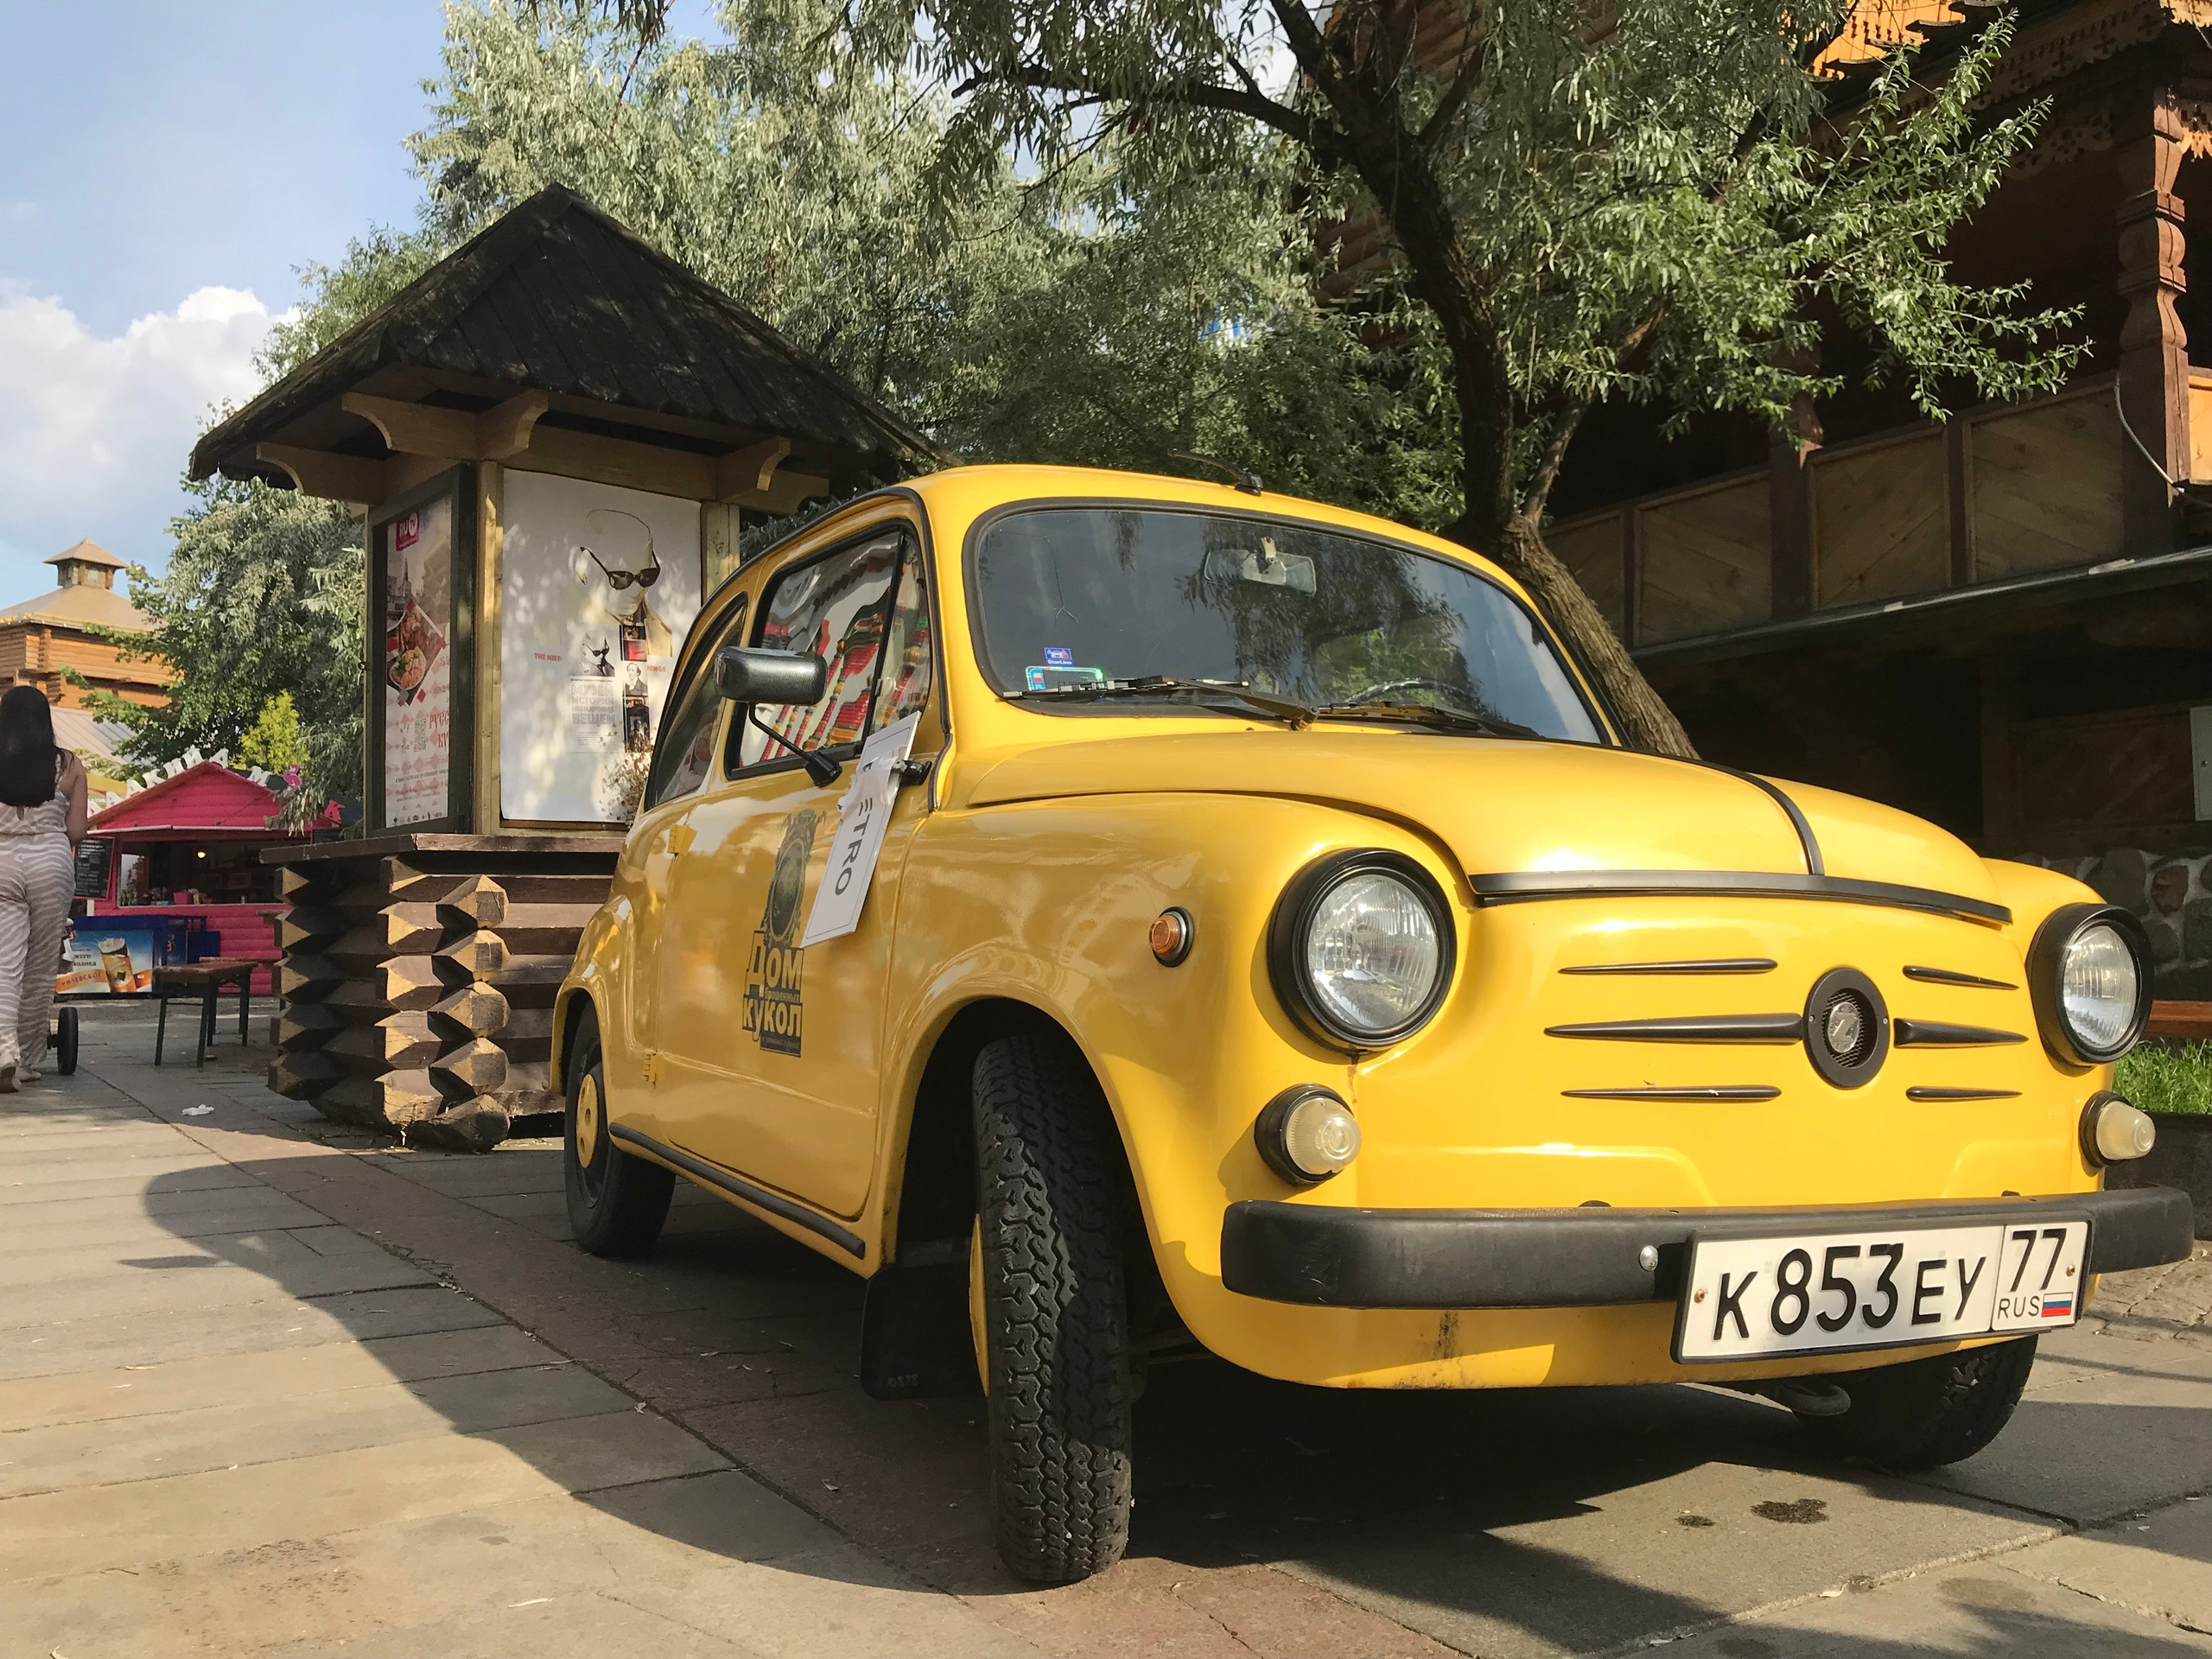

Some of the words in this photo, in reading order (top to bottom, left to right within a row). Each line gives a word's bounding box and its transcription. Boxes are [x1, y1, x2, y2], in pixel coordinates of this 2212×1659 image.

[399, 519, 409, 537] RU
[571, 682, 613, 696] МУЗЕЙ
[571, 696, 614, 705] ИСТОРИИ
[572, 712, 616, 727] ВЕЩЕЙ
[835, 758, 874, 896] ETRO
[2011, 1227, 2068, 1293] 77
[1997, 1295, 2041, 1320] RUS
